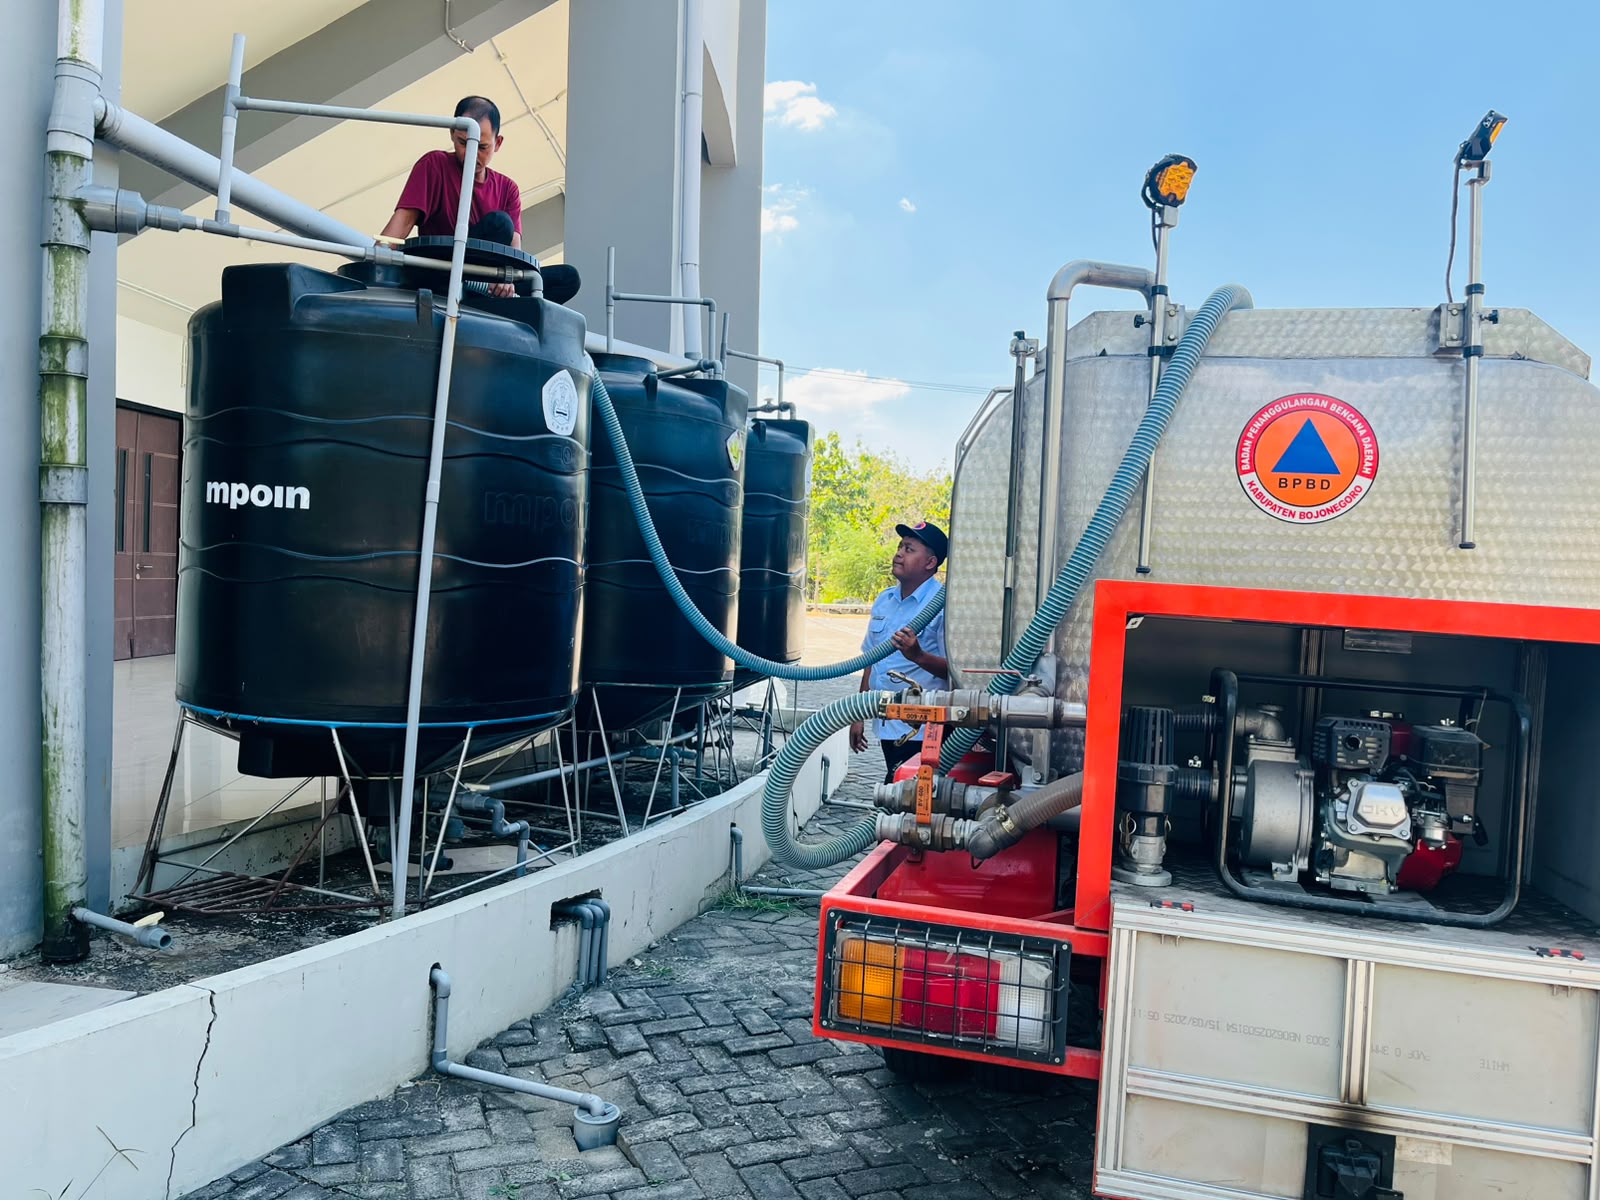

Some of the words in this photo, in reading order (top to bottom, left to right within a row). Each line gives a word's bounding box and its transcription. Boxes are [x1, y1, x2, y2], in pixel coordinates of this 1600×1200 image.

[1241, 440, 1252, 470] BADAN
[1251, 398, 1328, 438] PENANGGULANGAN
[1330, 404, 1367, 436] BENCANA
[1361, 437, 1373, 474] DAERAH
[206, 480, 311, 510] mpoin
[1246, 480, 1296, 519] KABUPATEN
[1299, 485, 1363, 520] BOJONEGORO
[1164, 1013, 1221, 1031] 15/03/2025
[1306, 1035, 1330, 1047] 3003
[1479, 1059, 1510, 1072] WHITE
